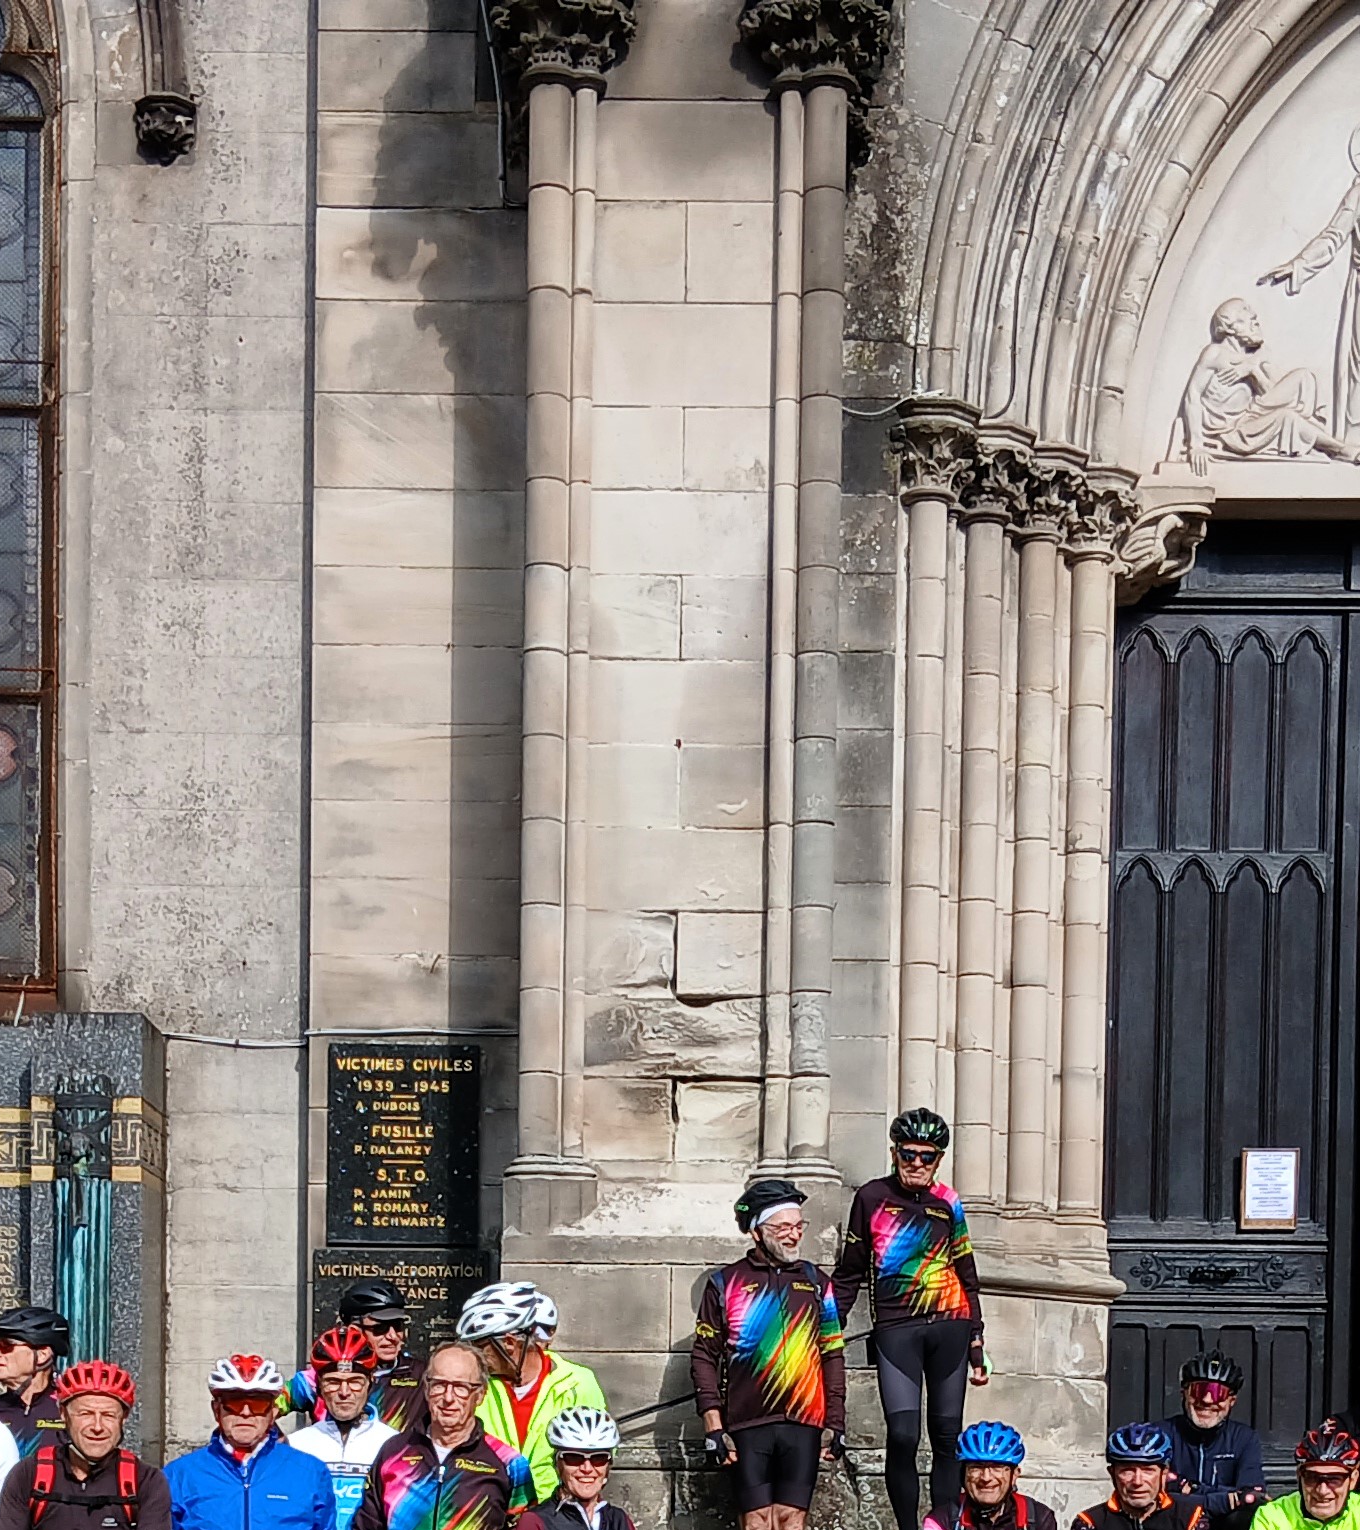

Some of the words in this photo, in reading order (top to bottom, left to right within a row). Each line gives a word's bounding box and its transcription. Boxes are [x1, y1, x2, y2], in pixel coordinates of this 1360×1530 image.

[336, 1058, 405, 1071] VICTIMES
[413, 1058, 473, 1071] CIVILES
[358, 1080, 394, 1092] 1939
[414, 1080, 450, 1093] 1945
[373, 1101, 421, 1111] DUBOIS
[370, 1145, 432, 1155] DALANZY
[371, 1189, 411, 1199] JAMIN
[373, 1203, 429, 1213] ROMARY
[373, 1216, 446, 1227] SCHWARTZ
